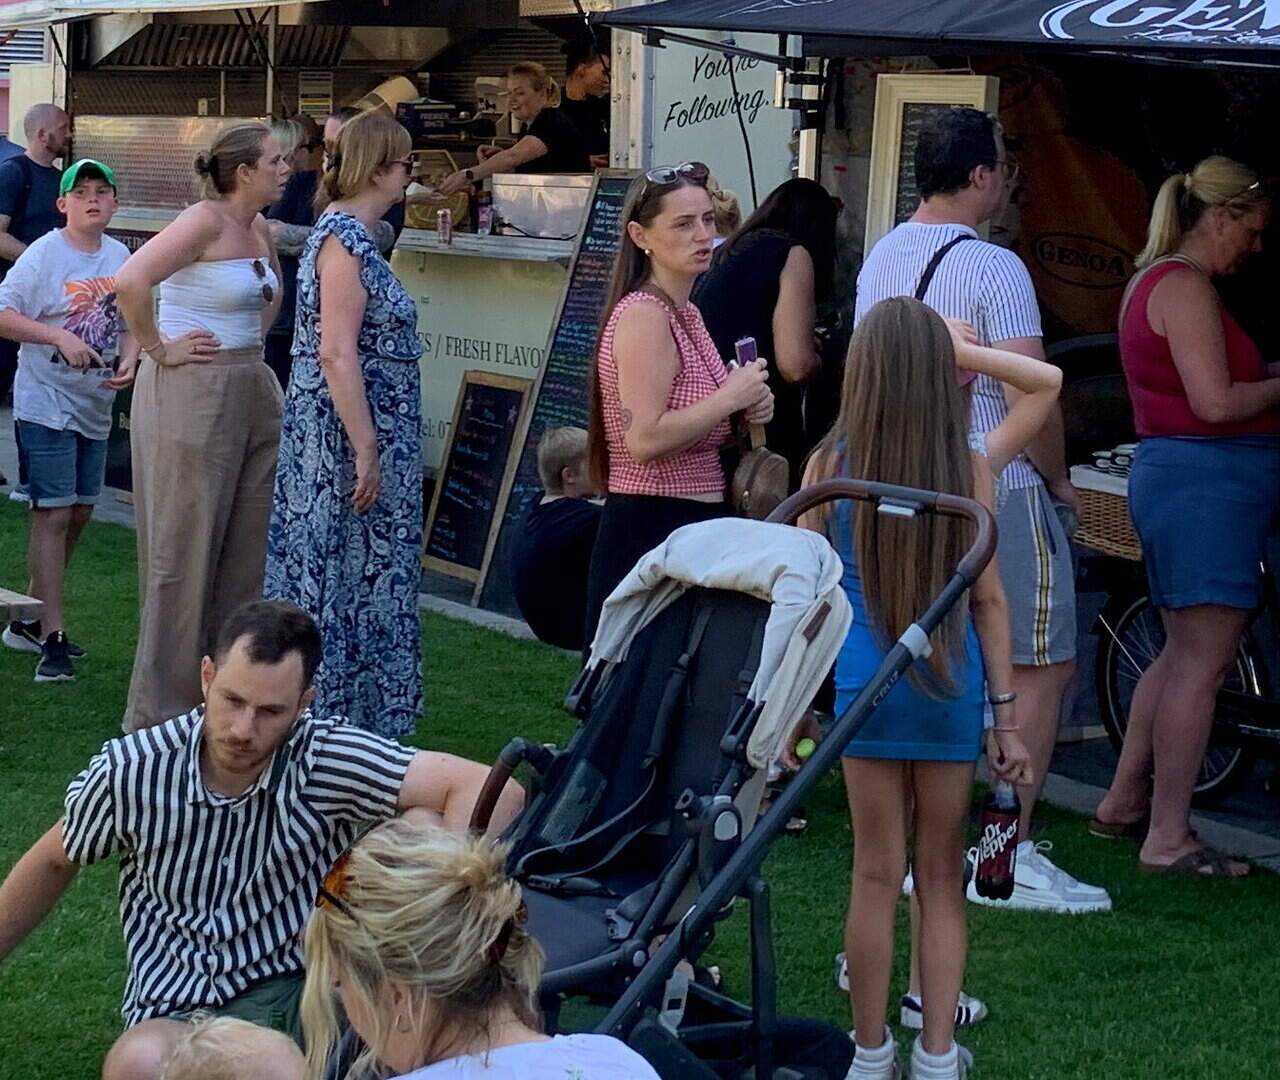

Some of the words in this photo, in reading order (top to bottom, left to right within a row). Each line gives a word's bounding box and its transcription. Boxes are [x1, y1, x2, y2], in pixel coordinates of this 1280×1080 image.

[1039, 240, 1127, 277] GENOA
[445, 336, 491, 362] FRESH
[495, 343, 546, 369] FLAVO
[421, 418, 436, 438] el:
[979, 818, 1019, 865] Pepper
[985, 821, 1001, 840] Dr
